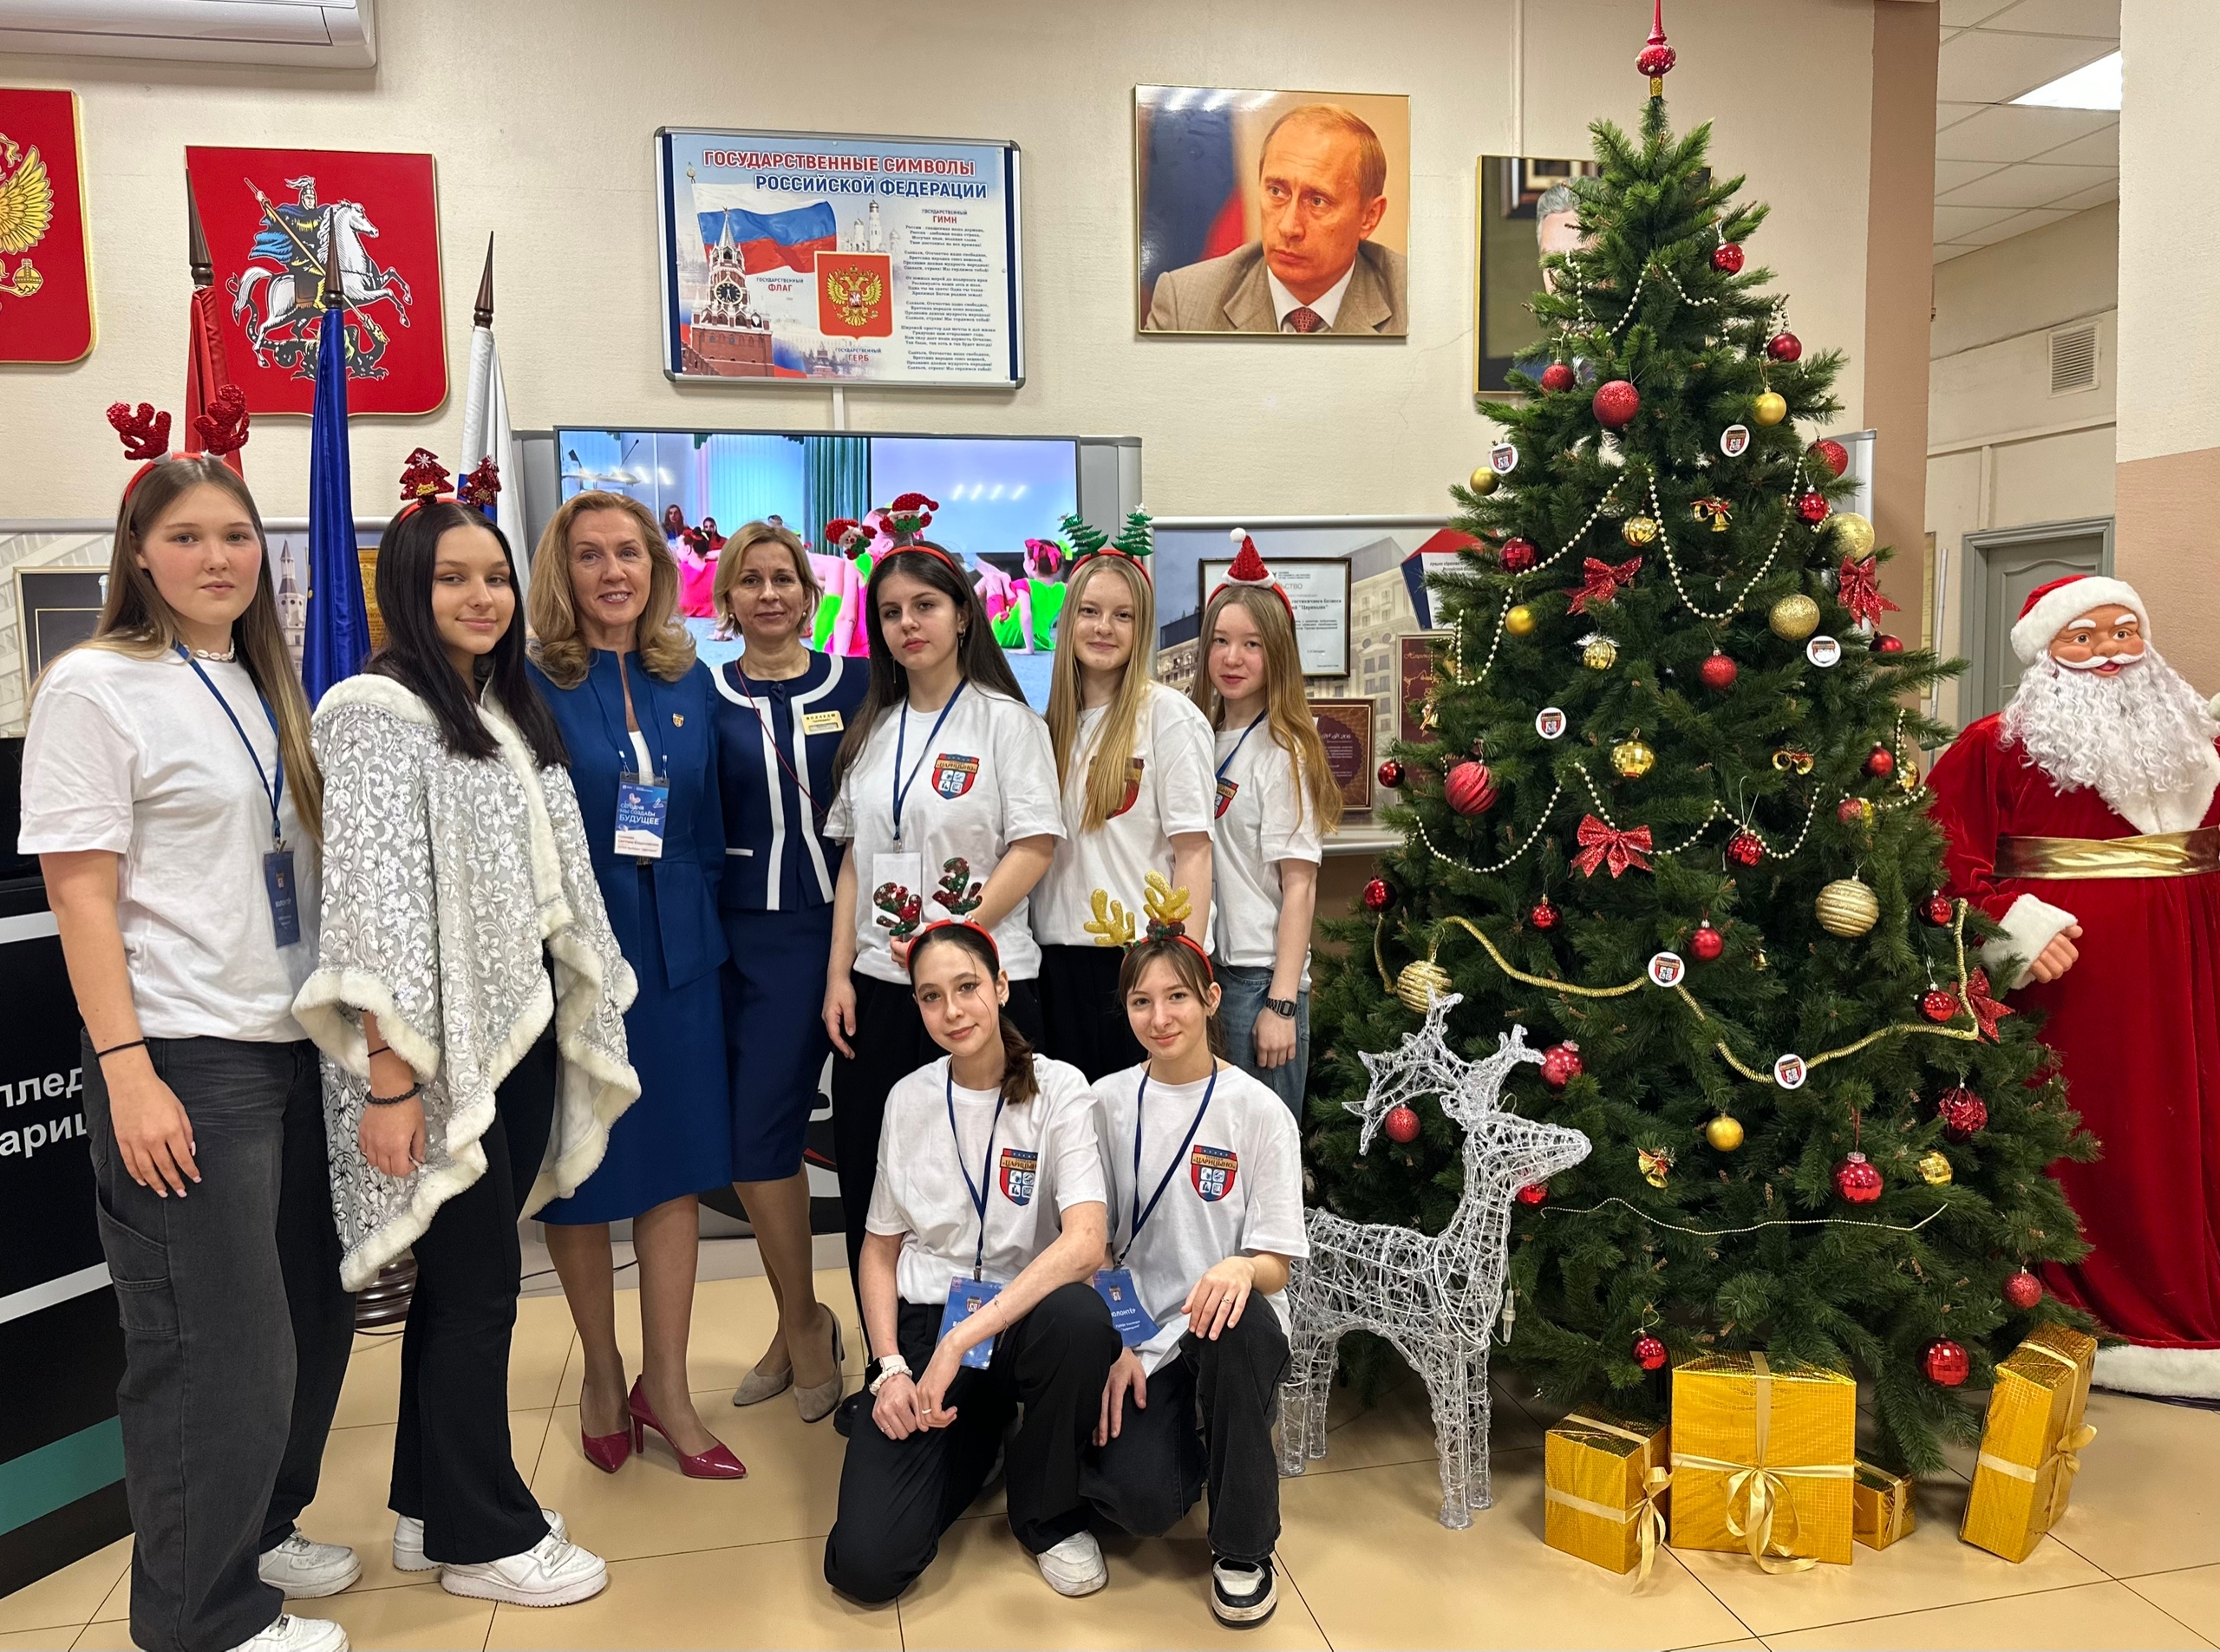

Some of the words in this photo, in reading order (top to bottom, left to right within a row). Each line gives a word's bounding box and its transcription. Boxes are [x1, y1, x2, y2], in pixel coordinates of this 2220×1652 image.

[704, 151, 878, 172] ГОСУДАРСТВЕННЫЕ
[883, 158, 976, 176] СИМВОЛЫ
[756, 175, 875, 194] РОССИЙСКОЙ
[879, 179, 987, 199] ФЕДЕРАЦИИ
[933, 215, 957, 224] ГИМН
[619, 814, 659, 825] БУДУЩЕЕ
